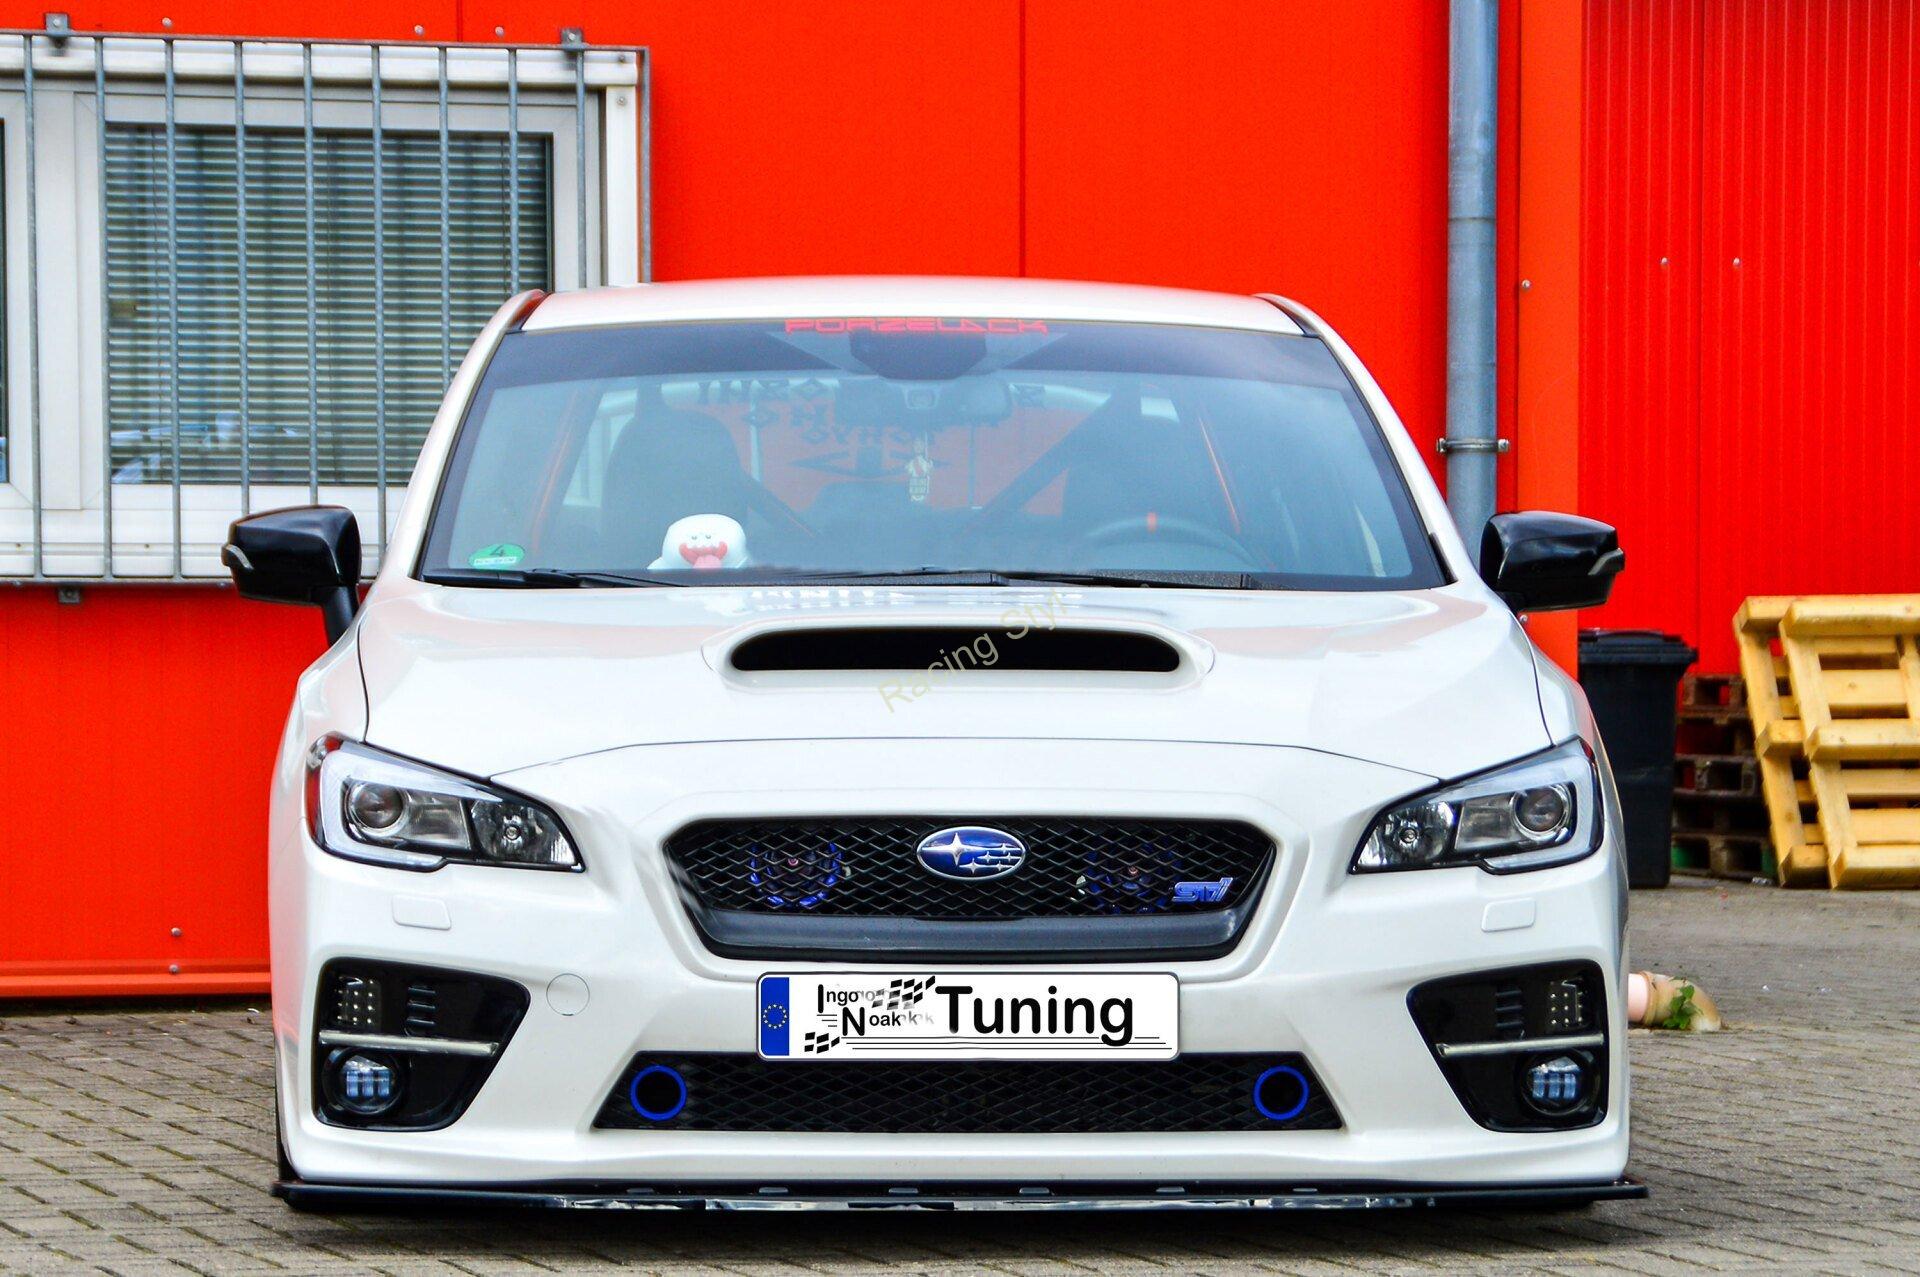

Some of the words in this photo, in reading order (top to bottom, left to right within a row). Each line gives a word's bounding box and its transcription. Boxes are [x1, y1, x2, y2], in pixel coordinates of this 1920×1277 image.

[817, 984, 859, 1014] Ingo
[842, 1006, 902, 1036] Noak
[935, 985, 1133, 1047] Tuning
